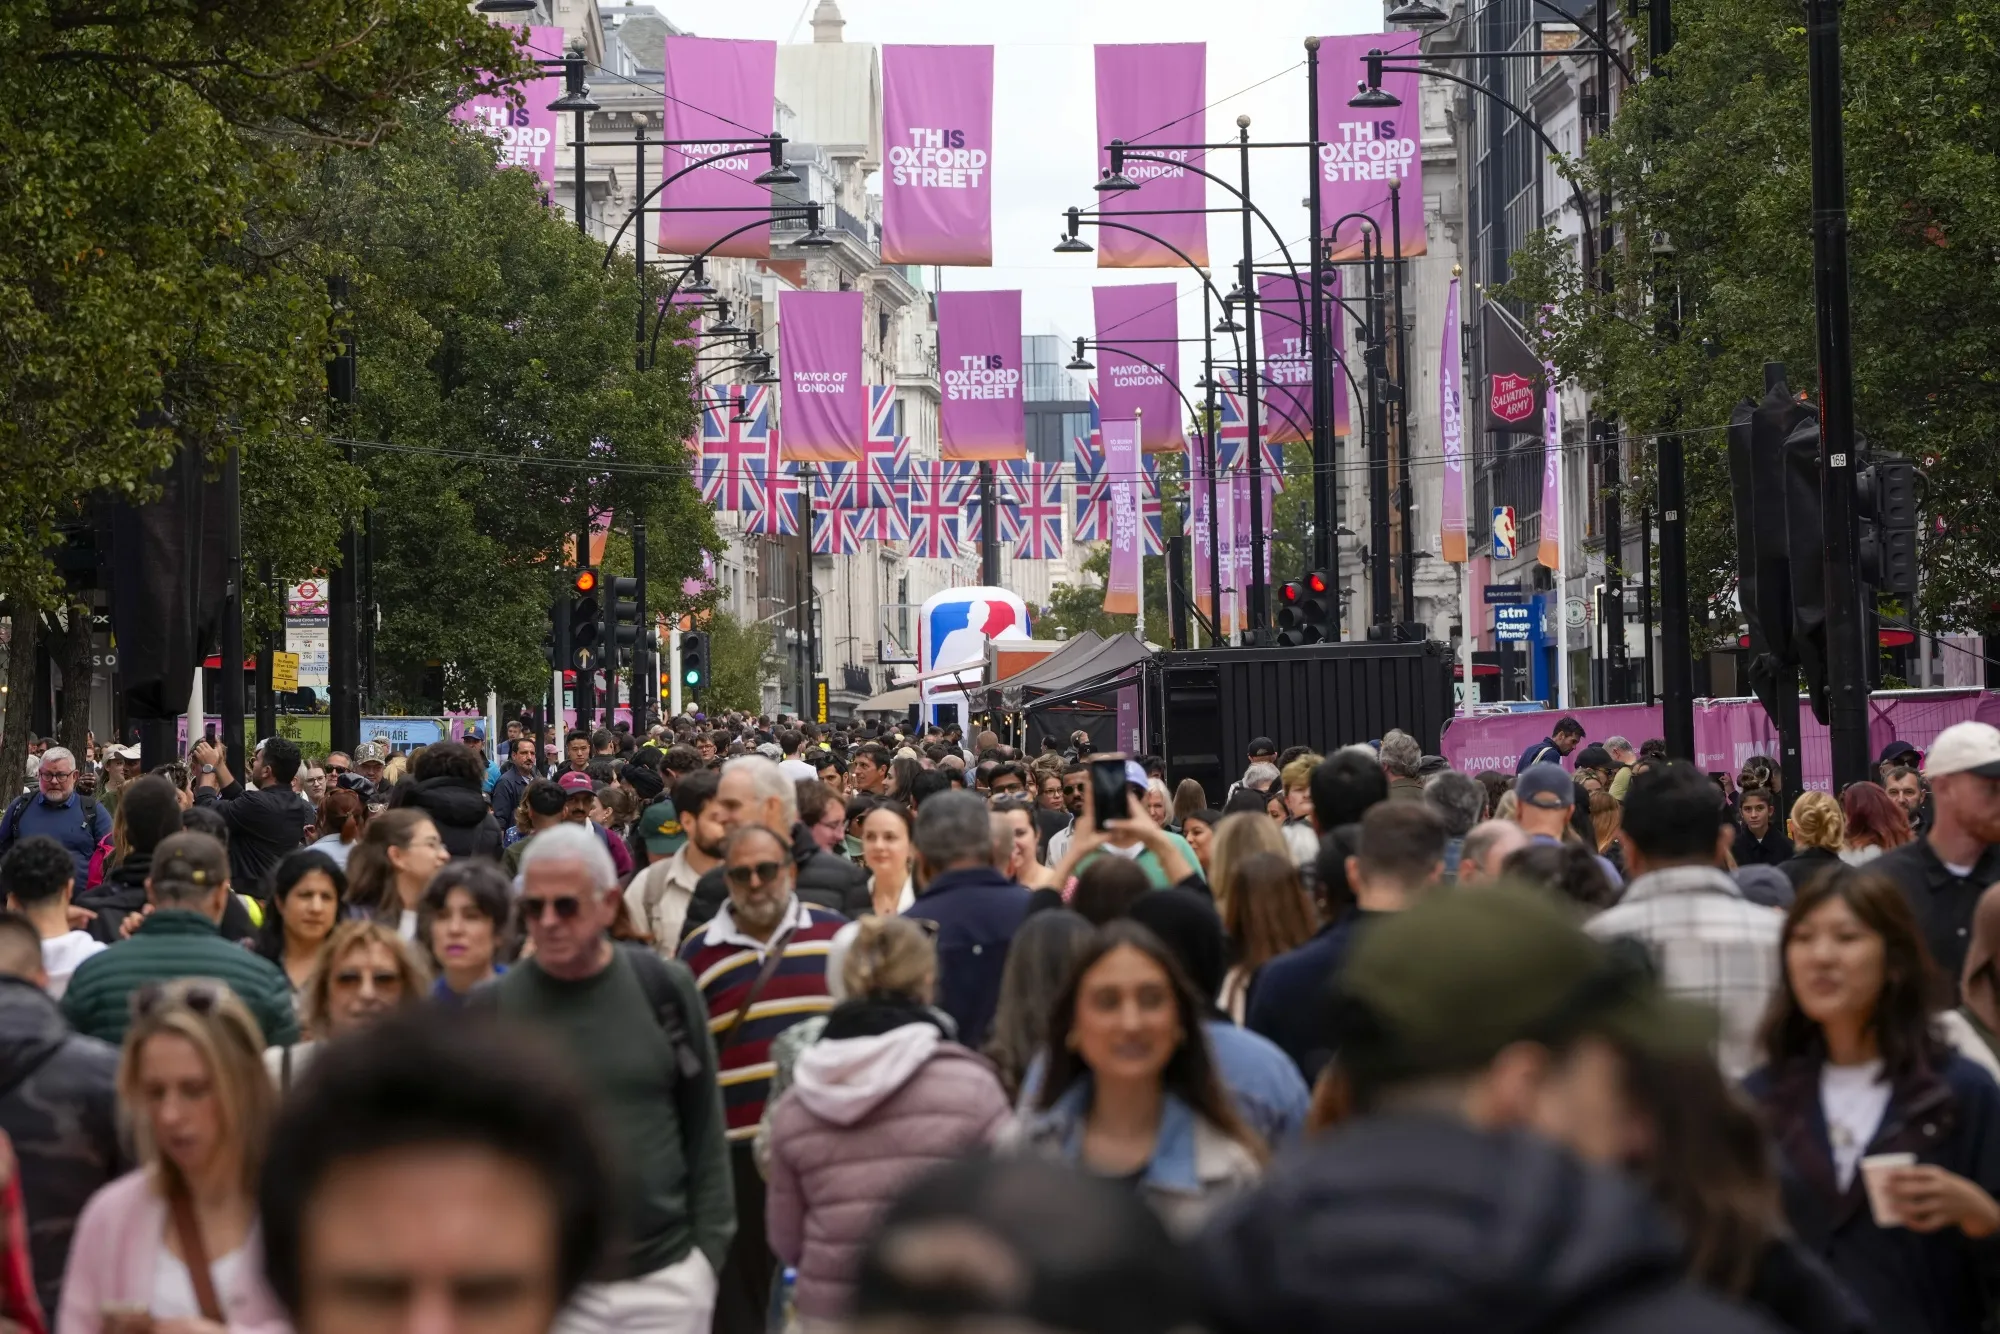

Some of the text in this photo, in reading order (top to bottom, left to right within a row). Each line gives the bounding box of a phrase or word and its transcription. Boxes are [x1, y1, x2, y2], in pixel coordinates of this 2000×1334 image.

[474, 105, 530, 127] THIS
[1338, 120, 1396, 142] THIS
[909, 128, 965, 149] THIS
[680, 143, 730, 155] MAYOR
[1319, 138, 1416, 162] OXFORD
[889, 146, 987, 168] OXFORD
[1169, 150, 1188, 163] OF
[684, 157, 749, 171] LONDON
[1324, 158, 1412, 182] STREET
[893, 166, 983, 188] STREET
[1122, 166, 1184, 178] LONDON
[960, 355, 1003, 370] THIS
[1110, 363, 1166, 376] MAYOR OF
[794, 371, 848, 382] MAYOR OF
[944, 368, 1020, 385] OXFORD
[1114, 375, 1163, 387] LONDON
[797, 383, 845, 393] LONDON
[947, 383, 1017, 400] STREET
[1501, 379, 1516, 392] THE
[1493, 386, 1531, 409] SALVATION
[1506, 397, 1529, 416] ARMY
[1832, 454, 1845, 466] 169
[1195, 507, 1205, 545] THIS
[1499, 607, 1528, 618] atm
[1496, 622, 1531, 631] Change
[1498, 631, 1529, 640] Money
[392, 730, 409, 741] ARE
[1464, 756, 1516, 770] MAYOR OF
